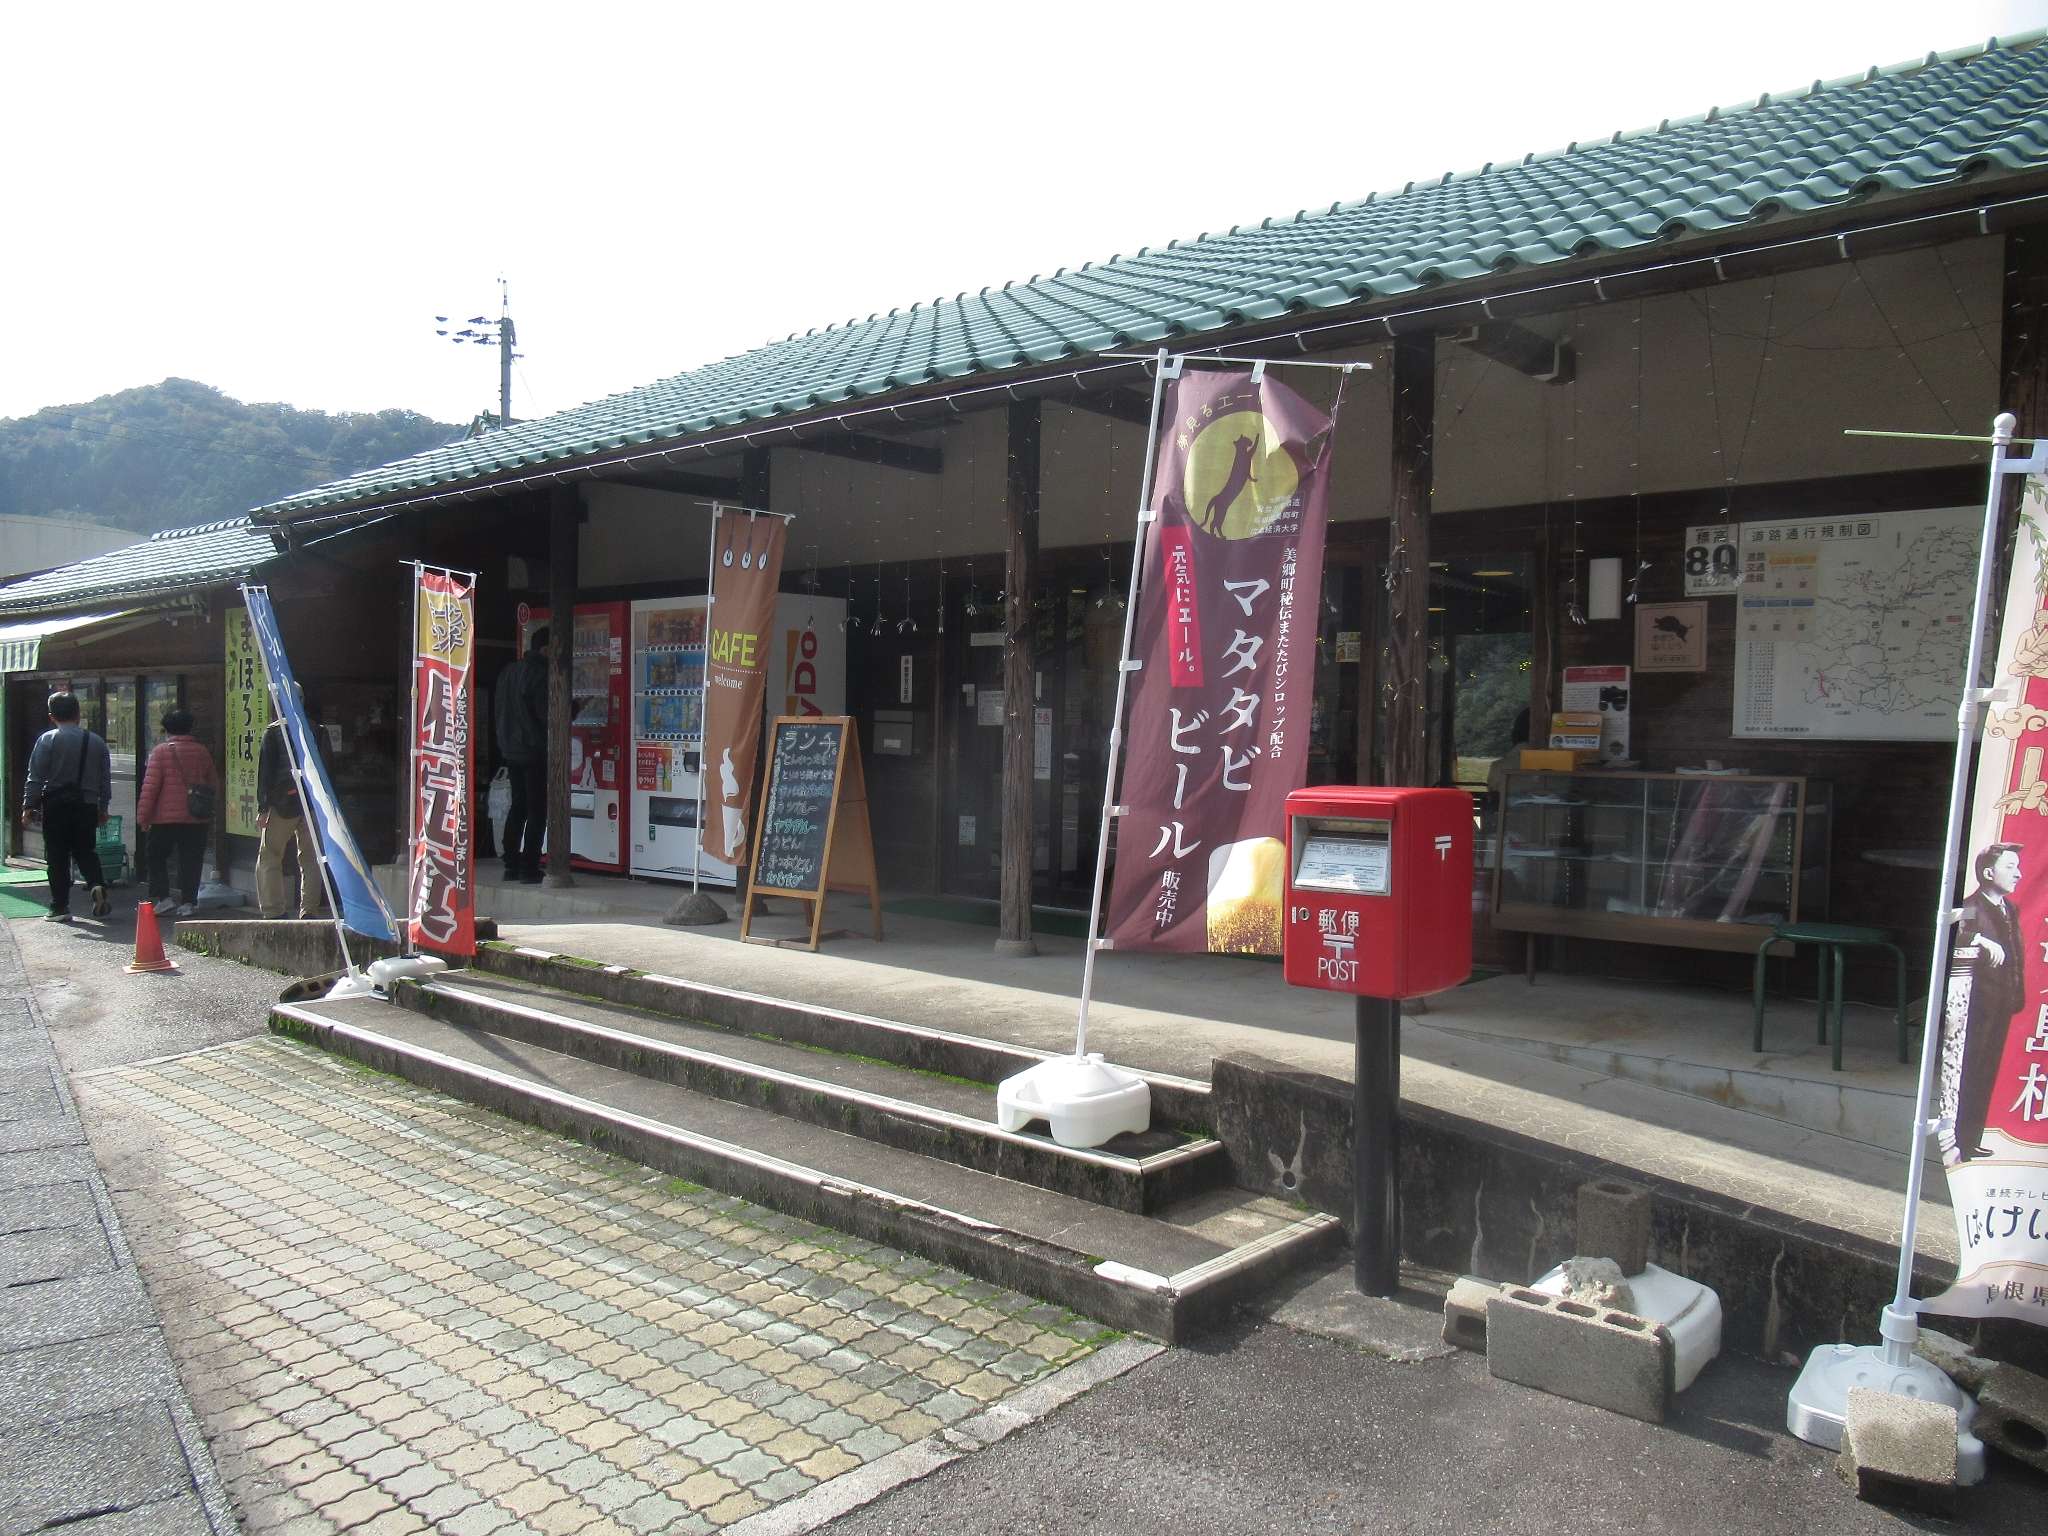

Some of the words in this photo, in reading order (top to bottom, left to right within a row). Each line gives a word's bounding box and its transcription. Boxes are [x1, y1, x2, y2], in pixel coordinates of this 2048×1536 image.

[1751, 522, 1872, 543] 道路通行規制図
[1171, 545, 1197, 673] 元気にエール。
[711, 629, 758, 667] CAFE
[1269, 547, 1298, 760] 美郷町秘伝またたびシロップ配合
[714, 674, 743, 690] welcome
[1218, 577, 1271, 791] マタタビ
[1148, 706, 1210, 859] ビール
[1154, 870, 1182, 928] 販売中
[1318, 908, 1360, 937] 郵便
[1317, 957, 1360, 983] POST
